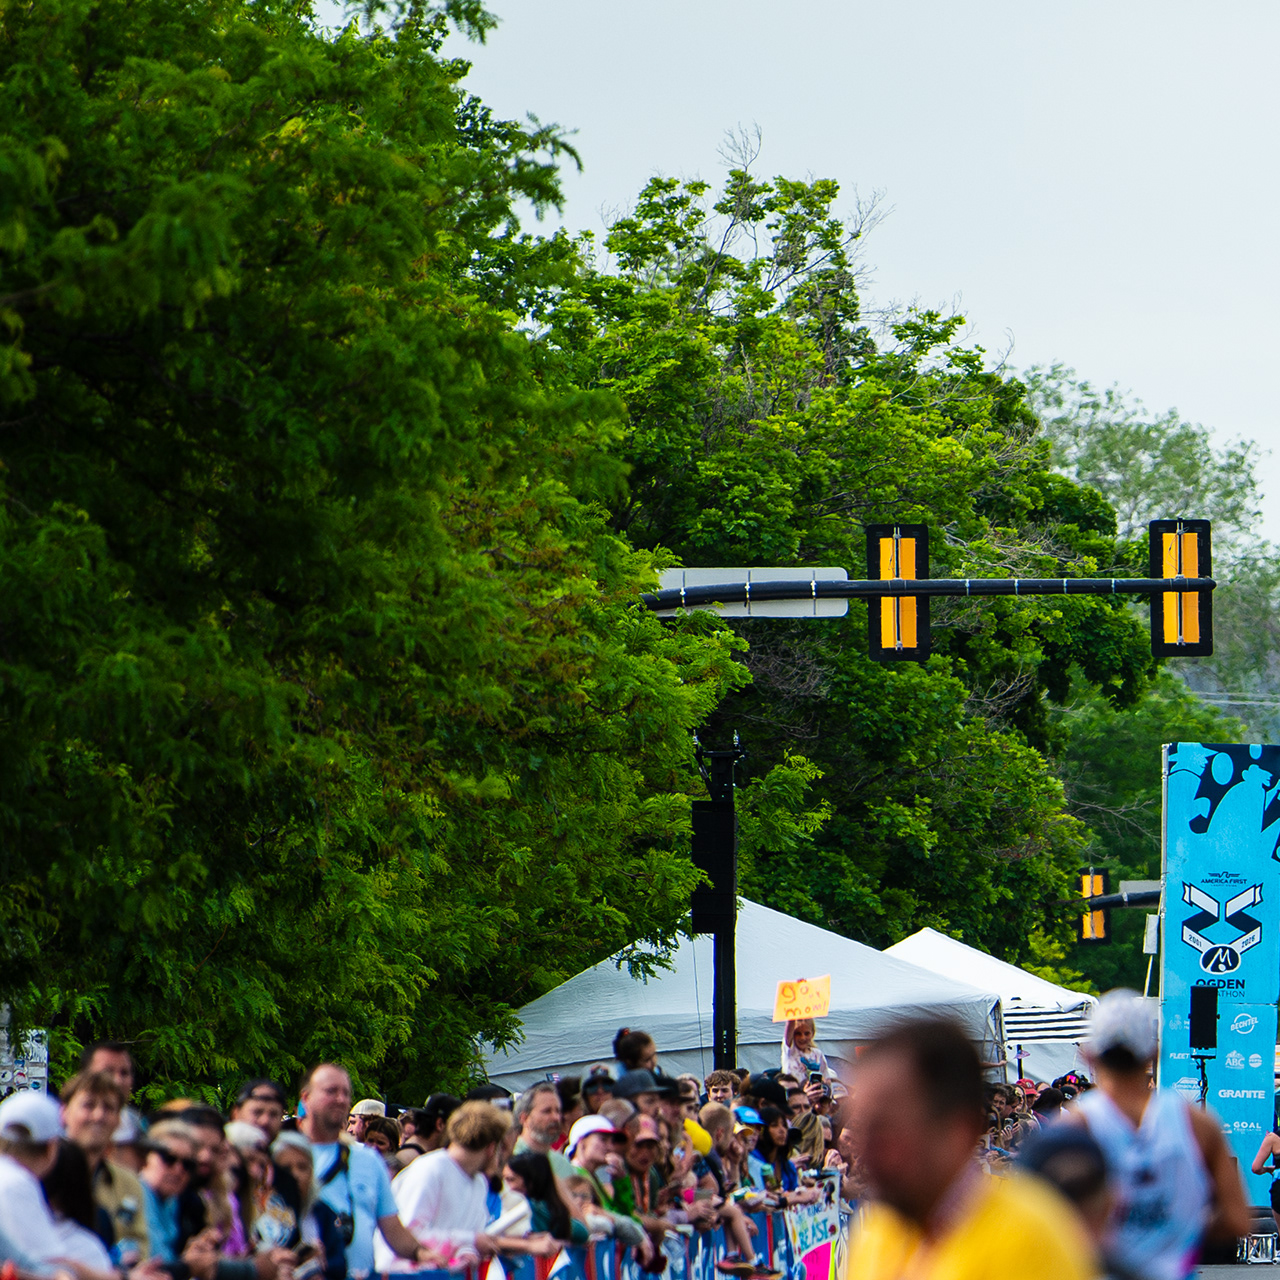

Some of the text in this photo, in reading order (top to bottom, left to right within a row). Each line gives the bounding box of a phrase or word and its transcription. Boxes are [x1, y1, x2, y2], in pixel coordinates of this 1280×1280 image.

[1230, 1016, 1259, 1032] BECHTEL
[1225, 1057, 1245, 1067] ABC
[1218, 1089, 1266, 1099] GRANITE
[1233, 1121, 1262, 1129] GOAL
